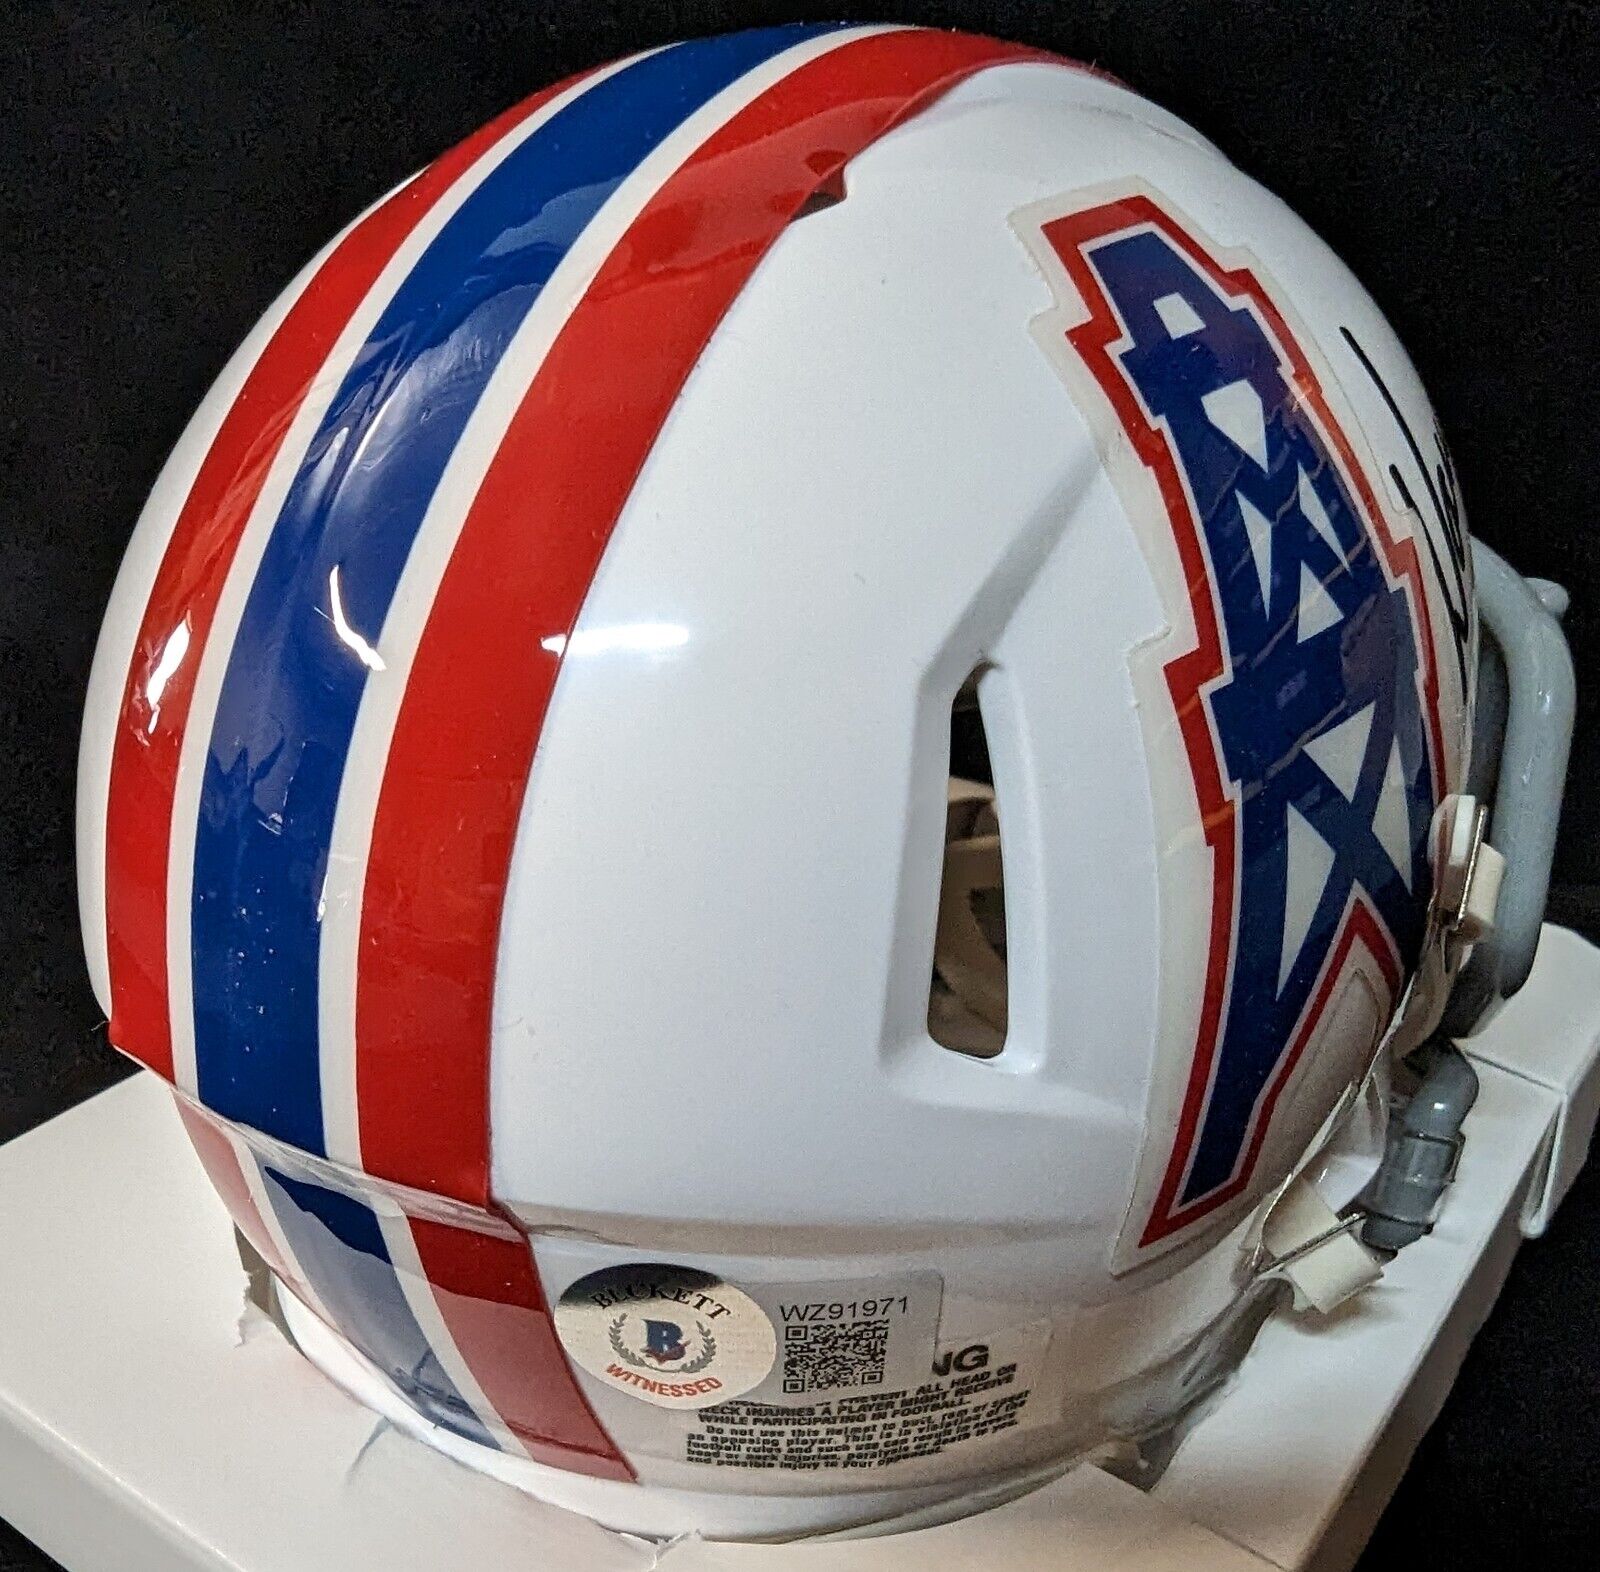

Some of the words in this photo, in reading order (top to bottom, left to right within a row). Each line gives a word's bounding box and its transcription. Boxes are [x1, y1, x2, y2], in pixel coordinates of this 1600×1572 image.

[779, 1296, 908, 1322] WZ91971
[606, 1363, 723, 1397] WITNESSED
[916, 1383, 943, 1395] ALL
[950, 1371, 991, 1388] HEAD
[745, 1407, 816, 1416] INJURIES
[821, 1406, 832, 1416] A
[836, 1400, 895, 1415] PLAYER
[698, 1413, 748, 1425] WHILE
[752, 1412, 866, 1426] PARTICIPATING
[870, 1411, 887, 1421] IN
[706, 1425, 724, 1435] Do
[730, 1428, 754, 1437] not
